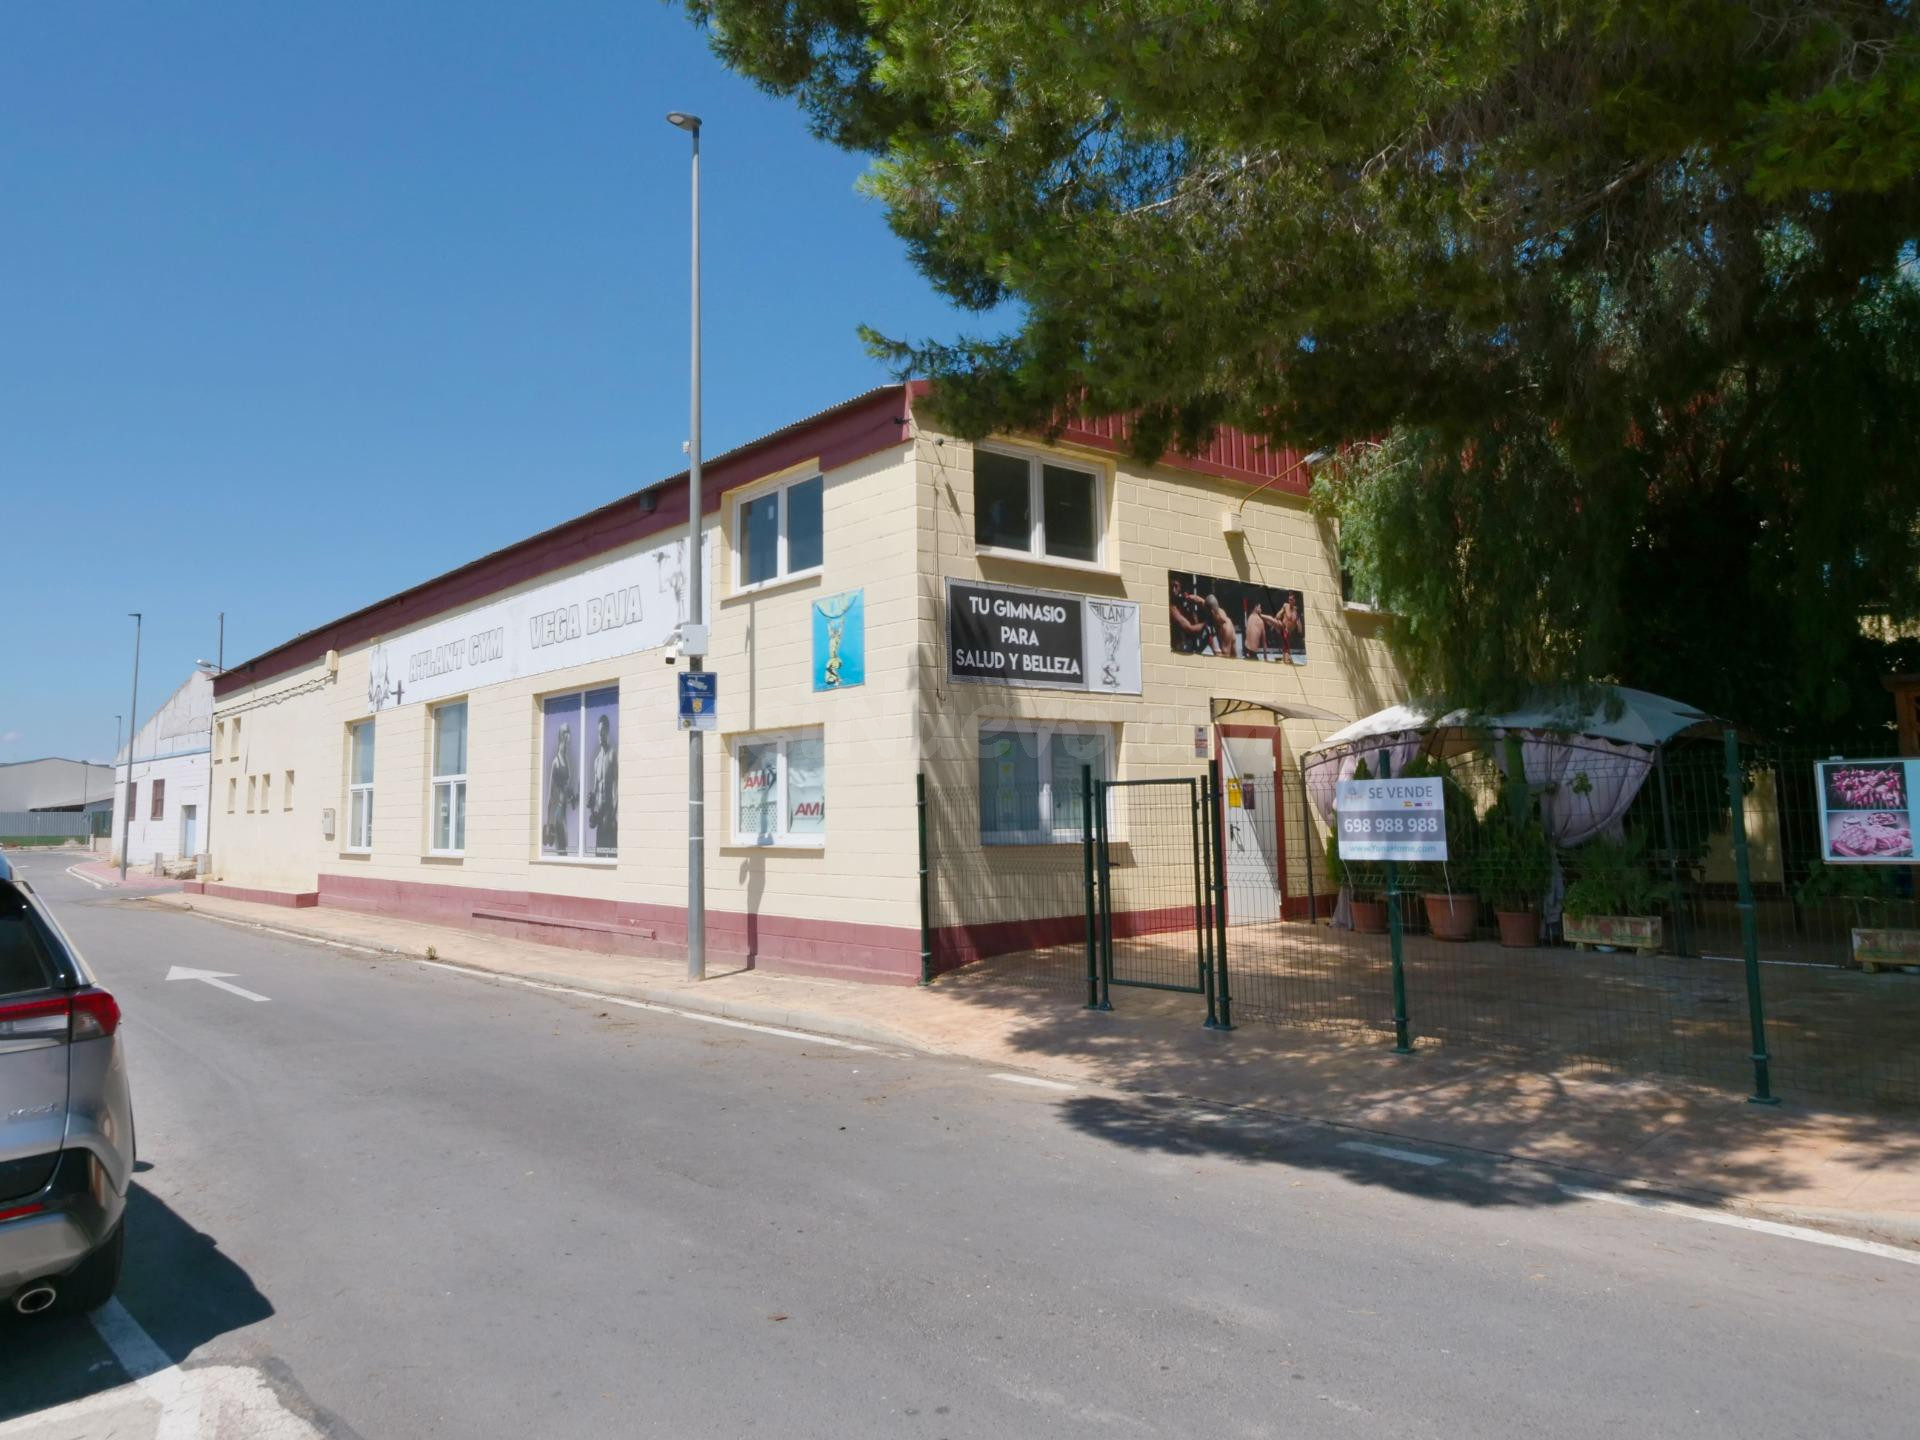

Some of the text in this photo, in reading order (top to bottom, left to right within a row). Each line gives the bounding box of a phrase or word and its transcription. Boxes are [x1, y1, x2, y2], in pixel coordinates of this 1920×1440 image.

[968, 596, 1067, 624] TU GIMNASIO
[409, 584, 643, 683] ATLANT GYM VEGA BAJA
[1000, 625, 1040, 646] PARA
[955, 648, 1081, 676] SALUD Y BELLEZA
[1368, 786, 1383, 799] SE
[1387, 785, 1433, 799] VENDE
[1343, 817, 1438, 833] 698 988 988
